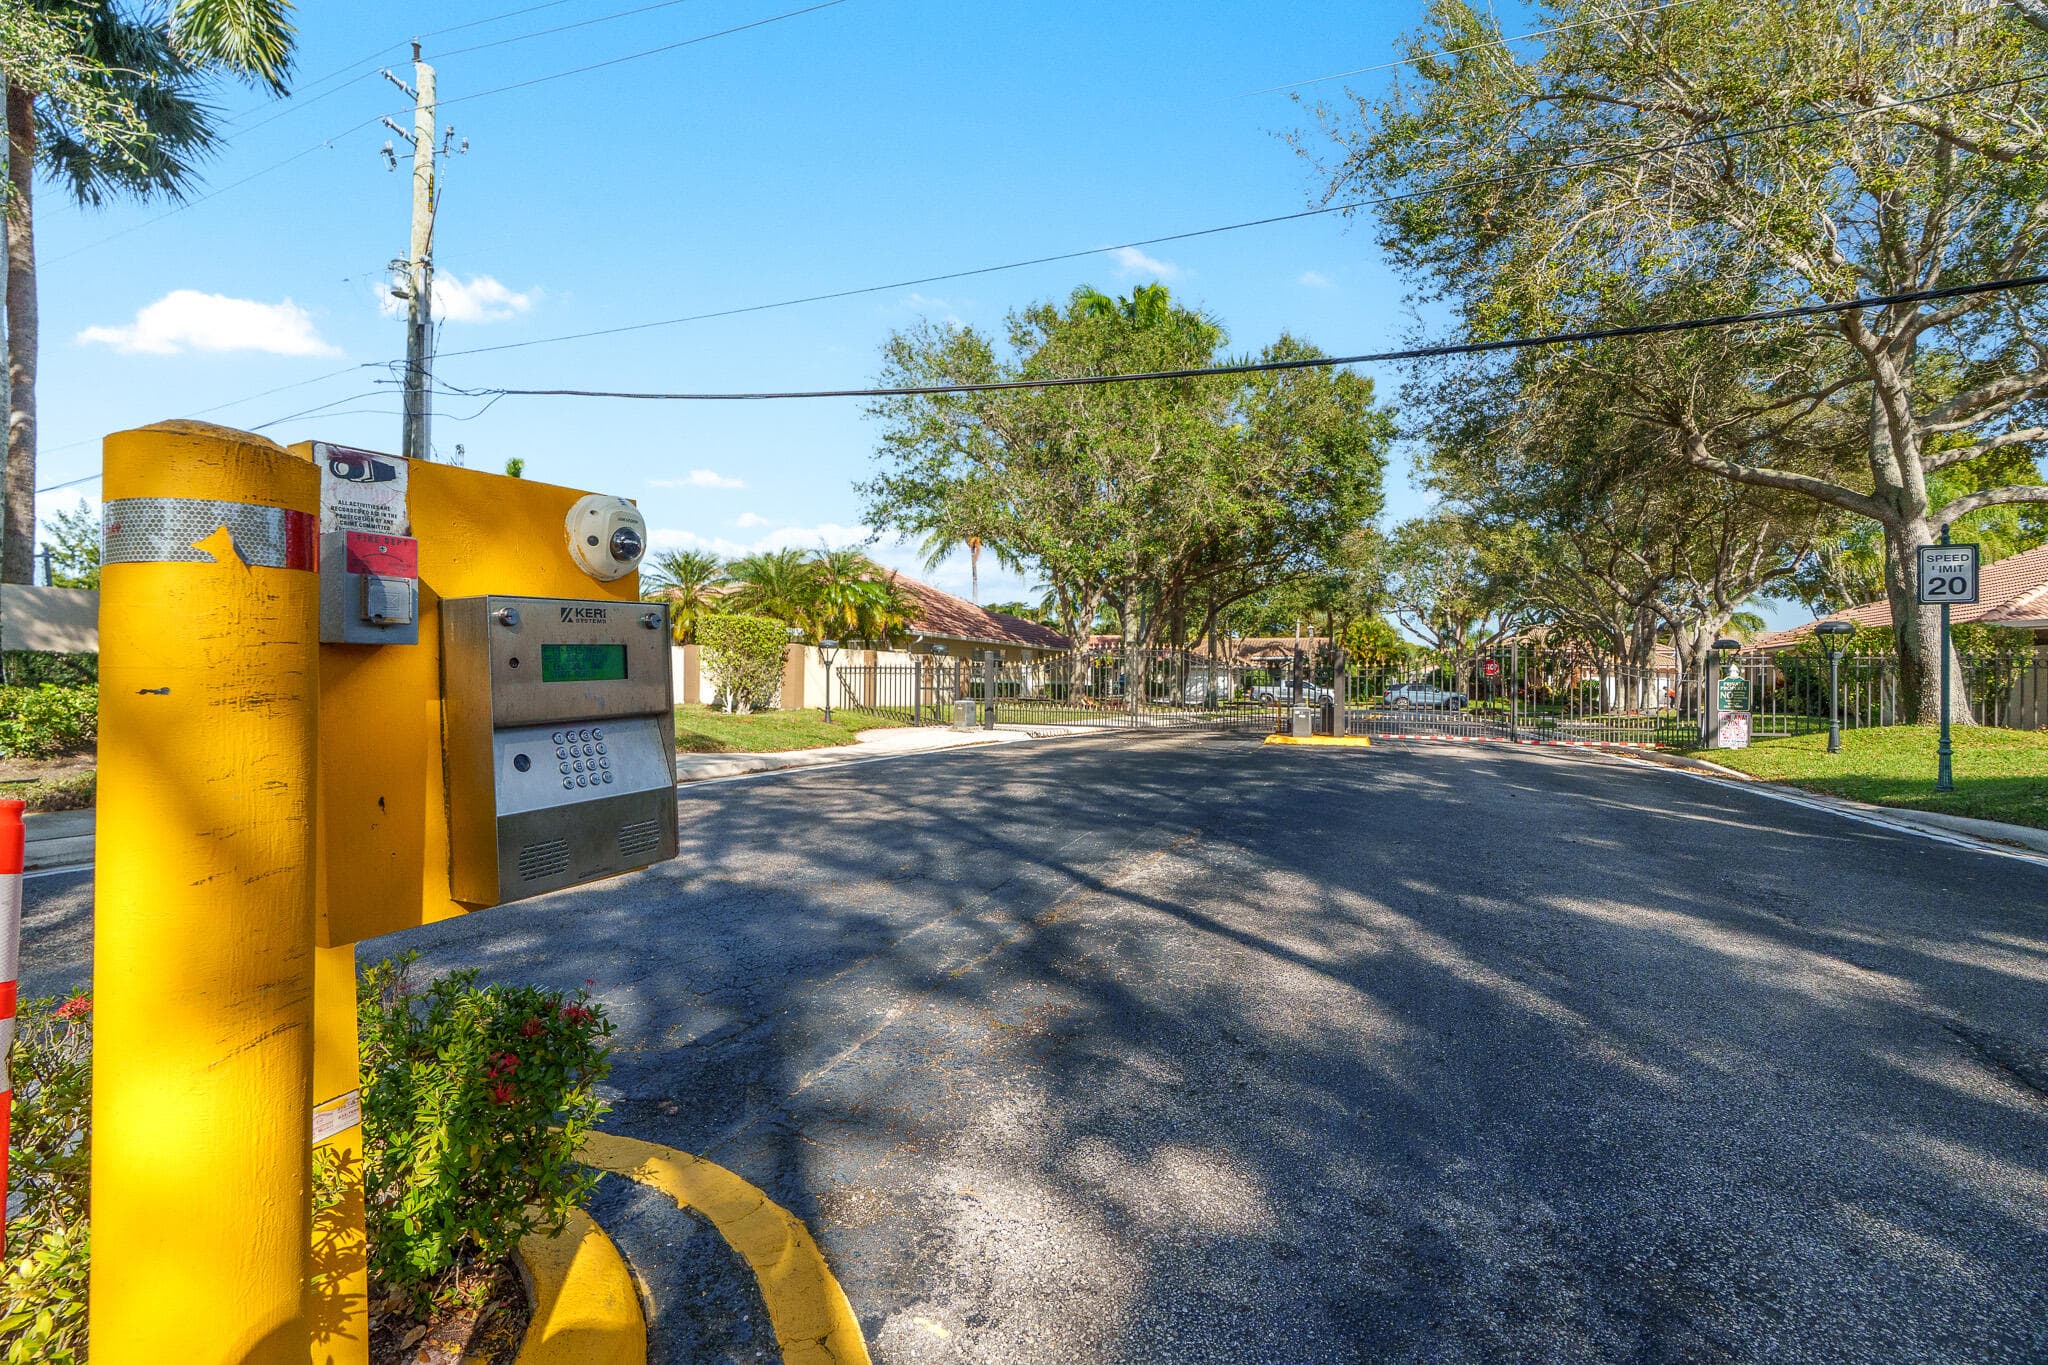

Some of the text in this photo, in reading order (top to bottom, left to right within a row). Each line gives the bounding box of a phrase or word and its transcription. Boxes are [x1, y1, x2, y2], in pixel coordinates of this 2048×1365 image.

[349, 501, 379, 510] ACTIVITIES
[340, 519, 391, 531] CRIME COMMITTED
[1926, 554, 1970, 562] SPEED
[1927, 576, 1968, 596] 20
[575, 607, 607, 619] KERI
[1720, 691, 1734, 699] NO
